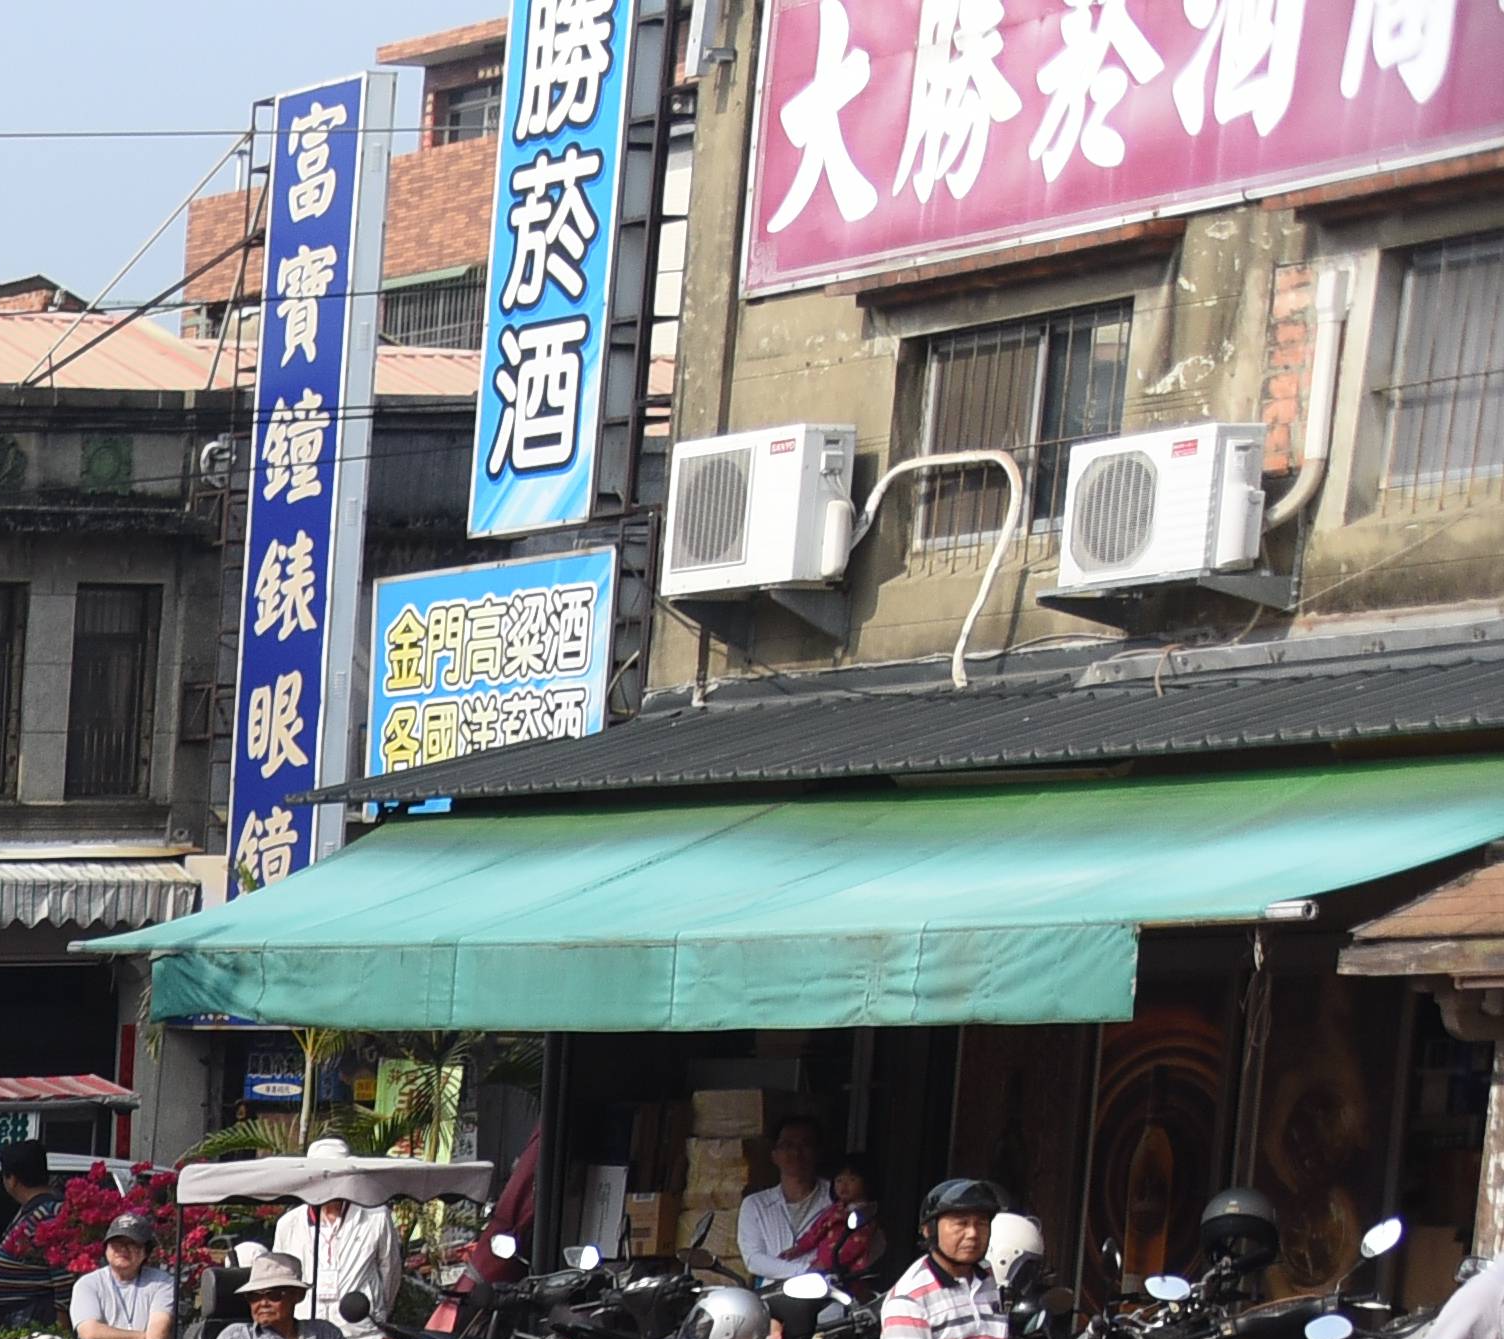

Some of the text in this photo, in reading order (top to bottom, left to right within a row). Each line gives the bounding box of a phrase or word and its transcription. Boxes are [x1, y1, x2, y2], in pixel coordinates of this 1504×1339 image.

[488, 0, 618, 481] 勝菸酒
[235, 100, 349, 896] 富寶鐘錶眼鏡
[384, 584, 596, 697] 金門高粱酒
[381, 687, 588, 773] 各國洋菸酒
